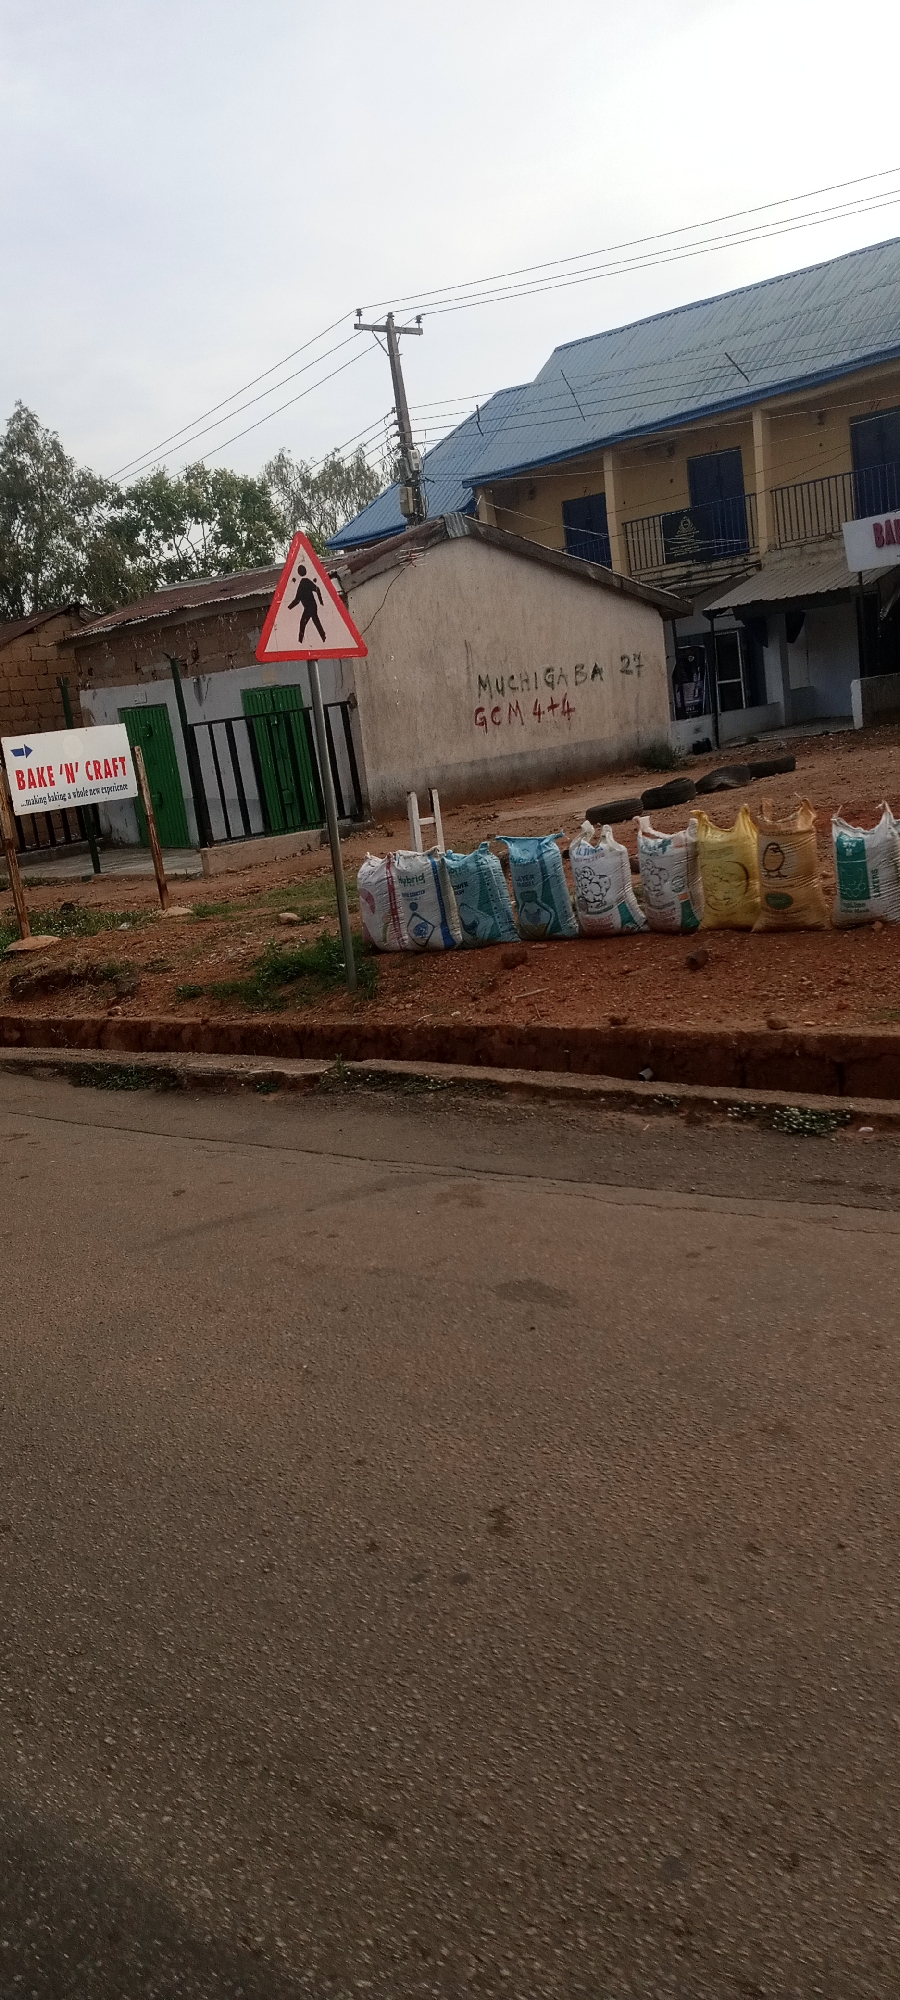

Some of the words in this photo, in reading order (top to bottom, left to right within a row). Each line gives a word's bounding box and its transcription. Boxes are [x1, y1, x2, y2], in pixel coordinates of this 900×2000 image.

[620, 651, 644, 677] 27
[15, 765, 55, 790] BAKE
[59, 762, 79, 784] 'N'
[85, 756, 126, 781] CRAFT
[48, 791, 66, 802] baking
[72, 786, 89, 798] whole
[89, 788, 101, 796] new
[101, 783, 128, 795] experience
